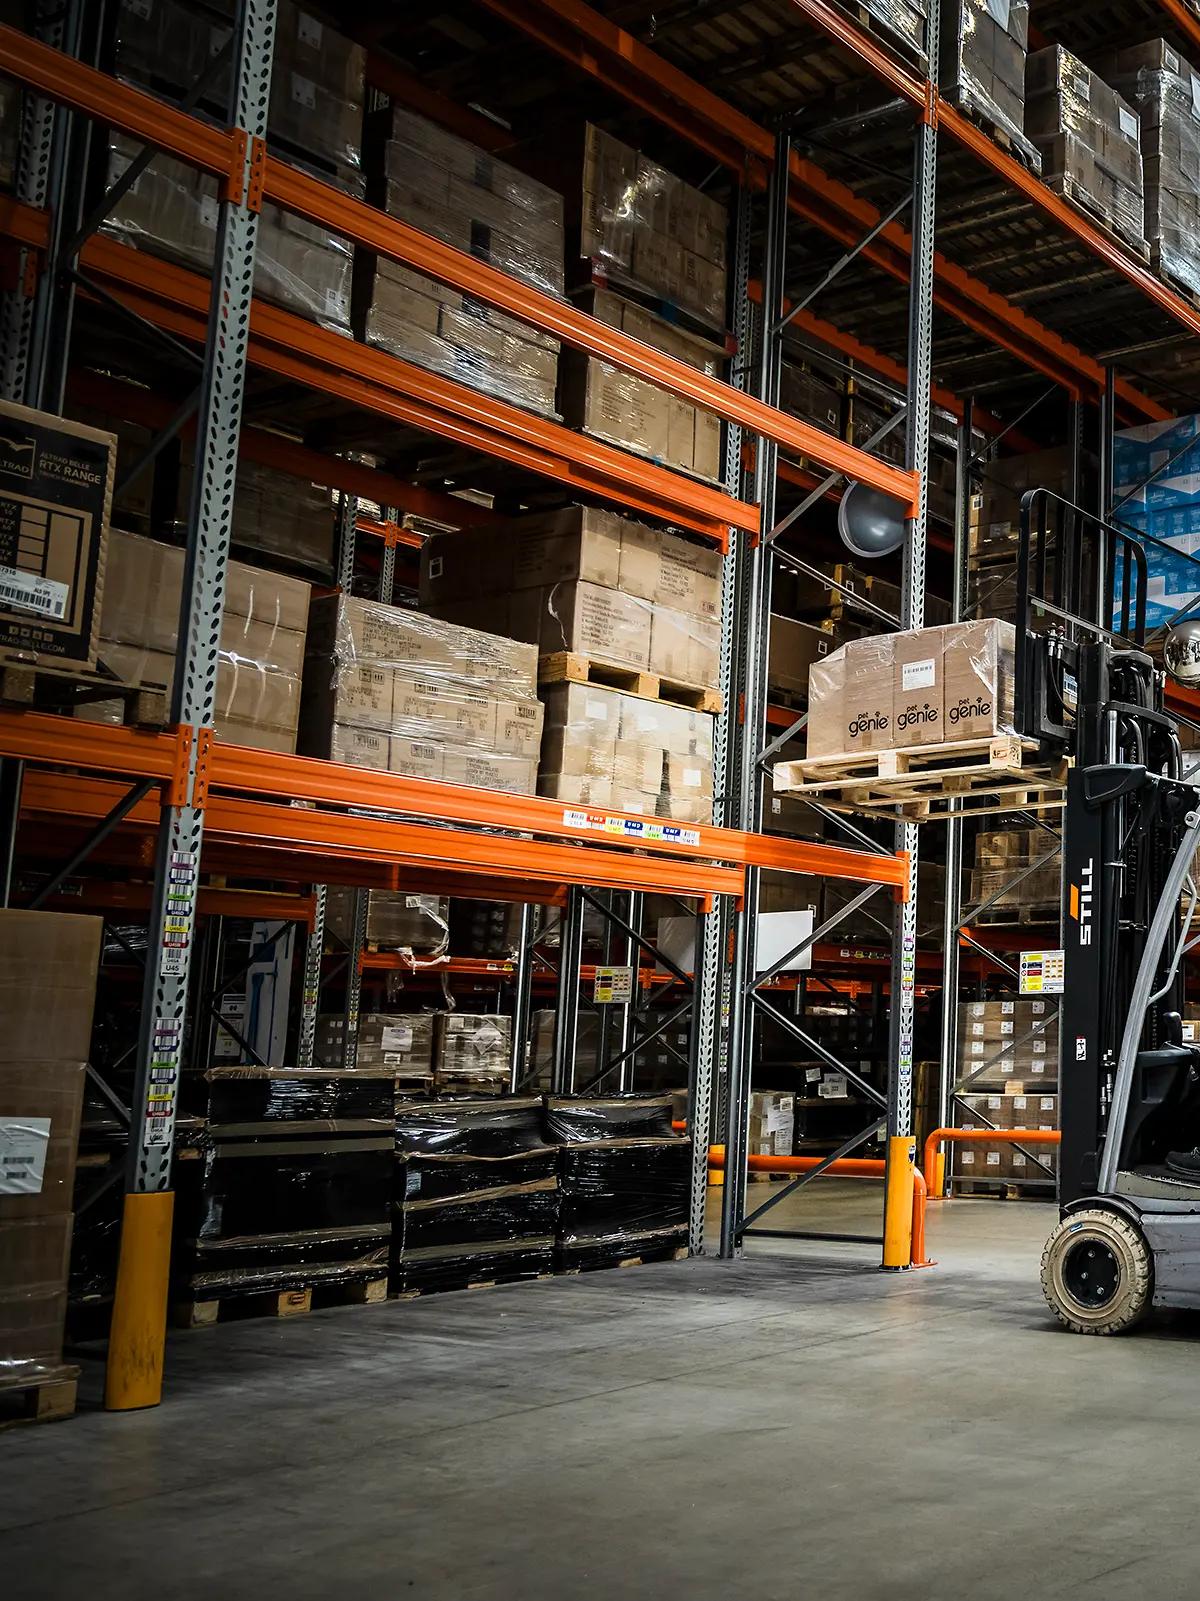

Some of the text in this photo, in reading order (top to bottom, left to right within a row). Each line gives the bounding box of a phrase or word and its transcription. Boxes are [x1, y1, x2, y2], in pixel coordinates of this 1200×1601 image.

[0, 460, 30, 473] TRAD
[40, 460, 102, 484] RTX RANGE
[906, 704, 918, 713] pet
[958, 698, 970, 706] pet
[858, 712, 868, 720] pet
[897, 709, 938, 730] genie
[949, 702, 990, 724] genie
[848, 716, 888, 738] genie
[1080, 858, 1094, 945] STILL
